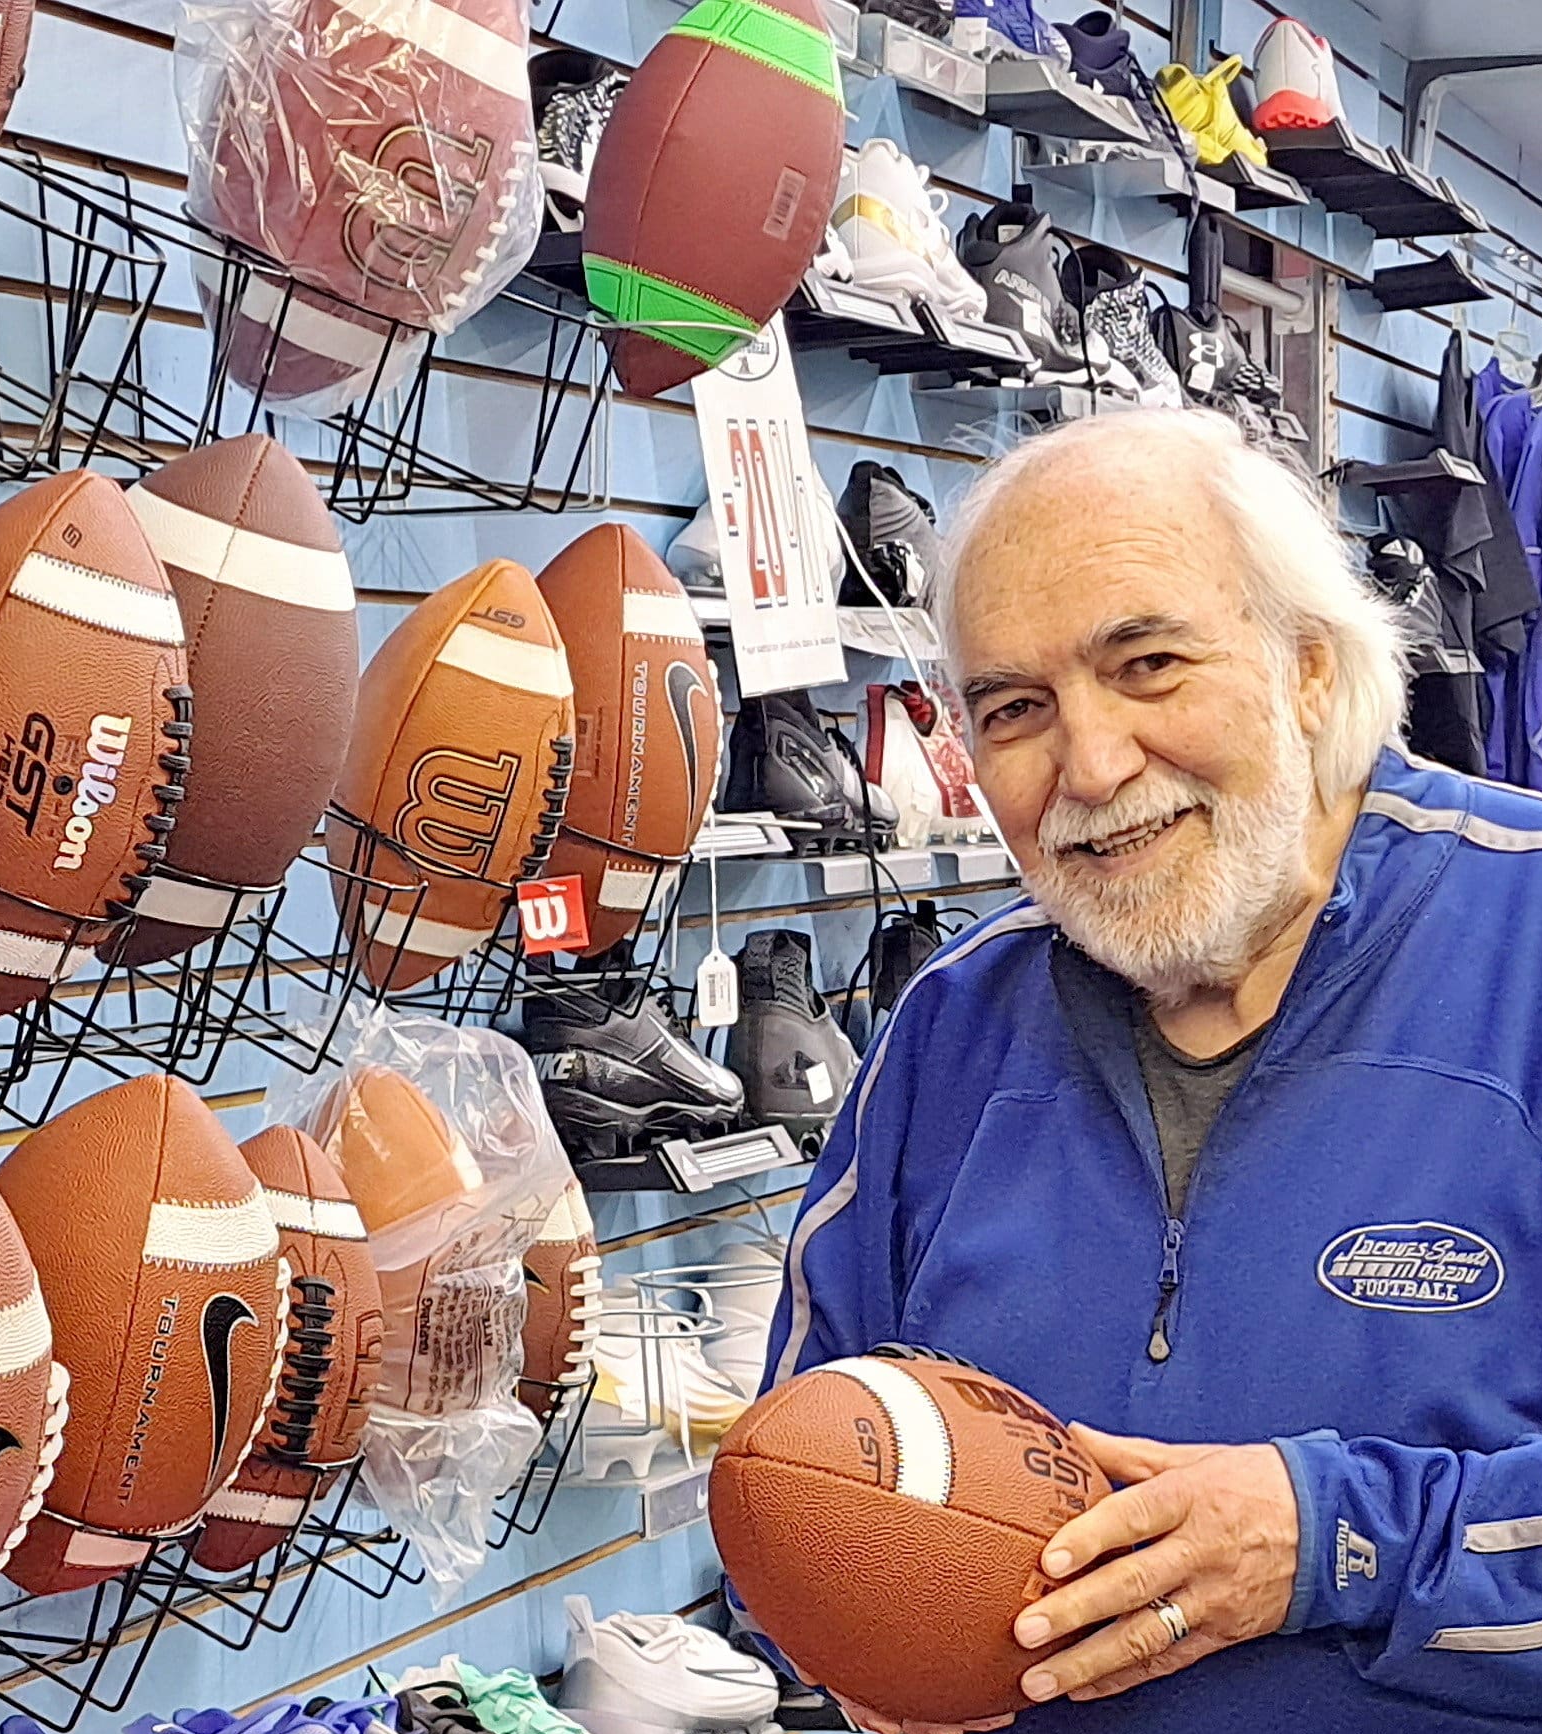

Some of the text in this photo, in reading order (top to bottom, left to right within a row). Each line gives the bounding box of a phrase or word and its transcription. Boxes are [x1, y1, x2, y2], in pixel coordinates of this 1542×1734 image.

[469, 605, 527, 628] GST
[6, 712, 56, 837] GST
[621, 661, 649, 848] TOURNAMENT
[53, 714, 133, 870] Wilson
[1350, 1278, 1460, 1302] FOOTBALL
[117, 1293, 180, 1508] TOURNAMENT
[853, 1416, 883, 1486] GST
[1022, 1446, 1093, 1494] GST
[1336, 1517, 1350, 1591] RUSSELL
